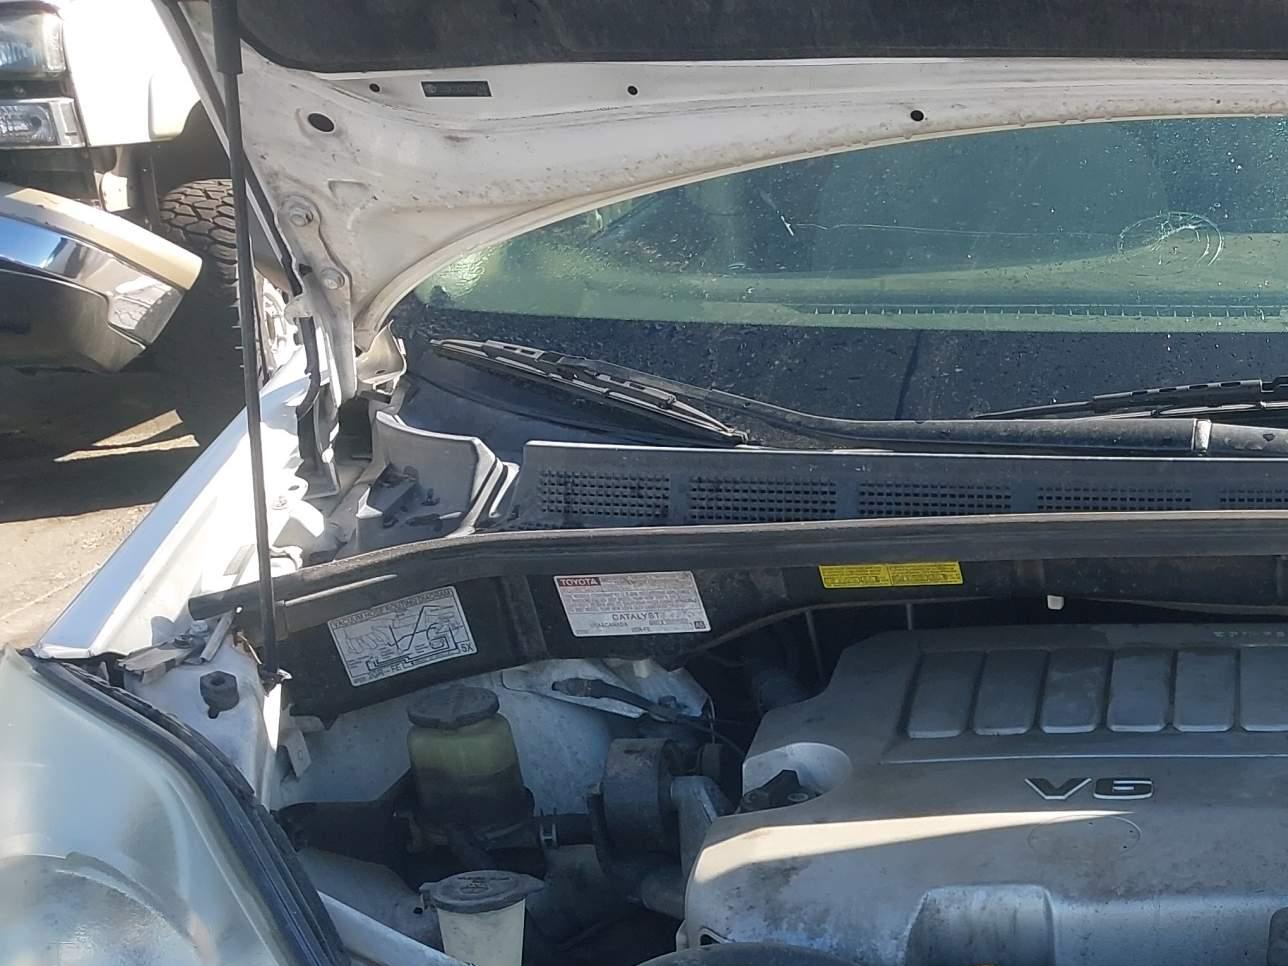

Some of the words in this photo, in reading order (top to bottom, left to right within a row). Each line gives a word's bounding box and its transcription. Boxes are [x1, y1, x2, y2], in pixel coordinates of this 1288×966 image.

[560, 578, 598, 586] TOYOTA
[612, 612, 659, 621] CATALYST
[461, 643, 474, 653] 5X
[1024, 778, 1153, 800] V6
